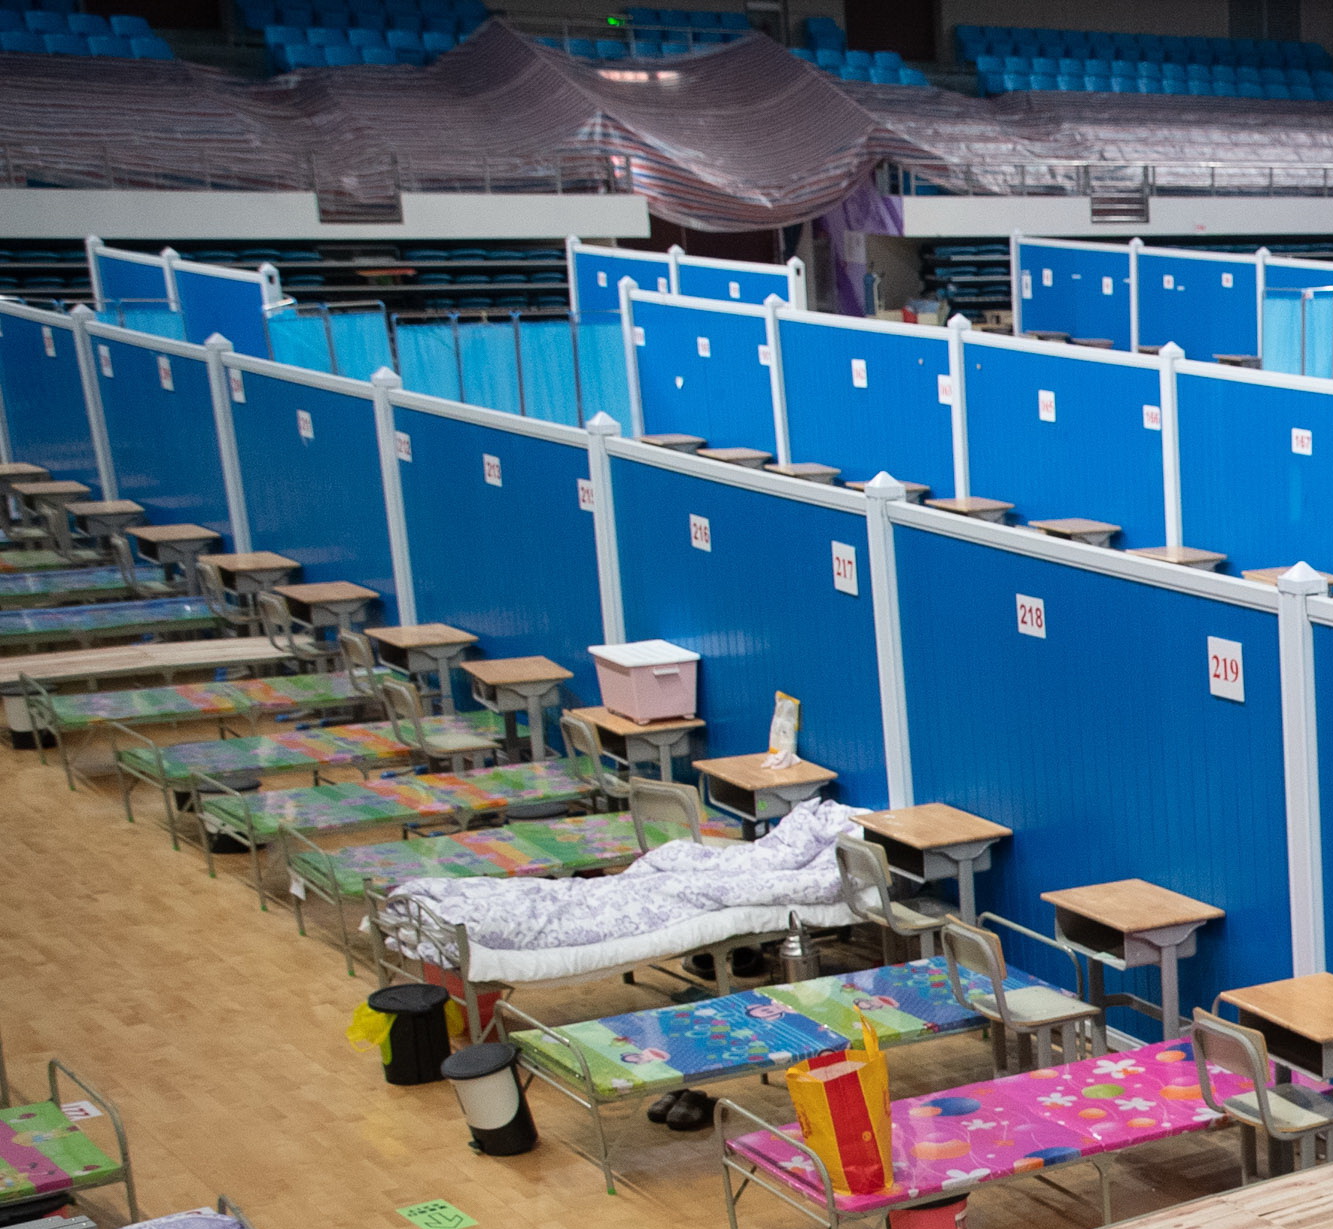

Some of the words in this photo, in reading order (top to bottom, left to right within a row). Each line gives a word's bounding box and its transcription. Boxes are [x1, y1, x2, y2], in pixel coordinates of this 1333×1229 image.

[1293, 432, 1311, 450] 167
[691, 523, 710, 545] 216
[834, 555, 854, 579] 217
[1018, 603, 1044, 629] 218
[1211, 655, 1239, 683] 219
